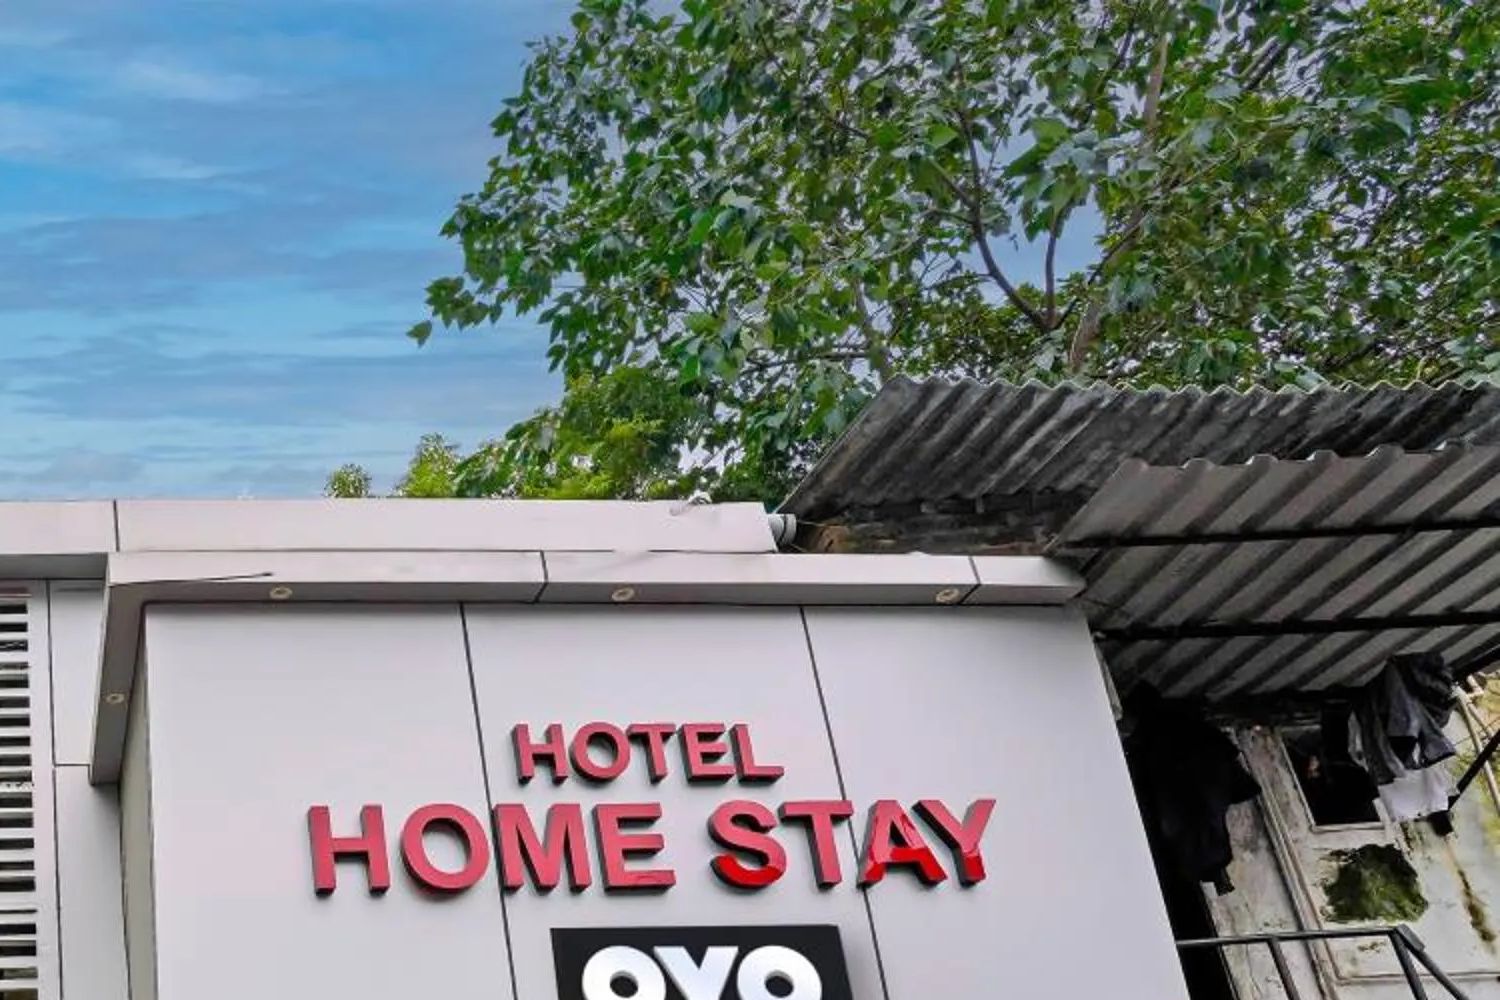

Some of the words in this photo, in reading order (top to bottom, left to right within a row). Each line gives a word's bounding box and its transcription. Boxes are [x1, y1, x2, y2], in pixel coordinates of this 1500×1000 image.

[511, 722, 785, 785] HOTEL
[308, 802, 676, 898] HOME
[708, 799, 997, 890] STAY
